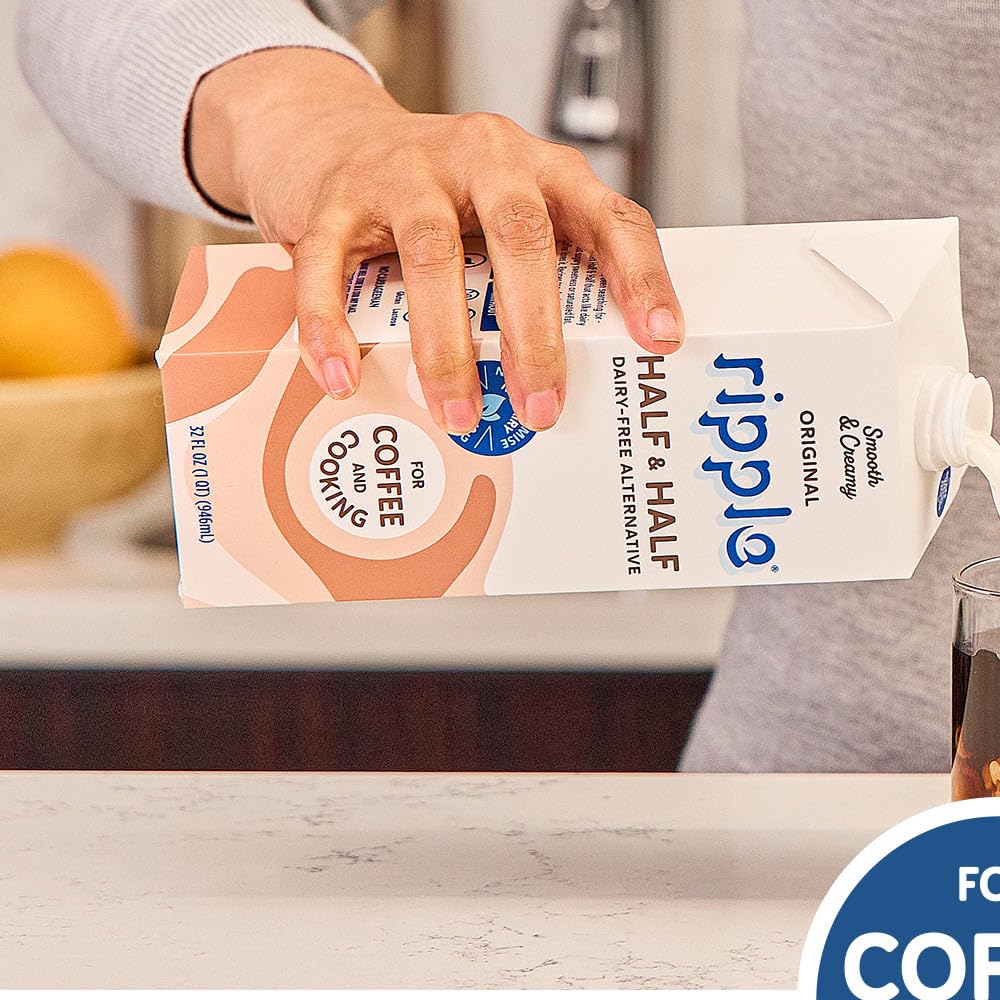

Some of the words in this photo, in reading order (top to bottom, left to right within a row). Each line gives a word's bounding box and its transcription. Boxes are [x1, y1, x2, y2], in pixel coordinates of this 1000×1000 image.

[190, 425, 204, 437] 32
[612, 356, 632, 458] DAIRY-FREE
[636, 355, 671, 450] HALF
[839, 415, 859, 432] &
[191, 440, 206, 450] FL
[192, 453, 207, 466] OZ
[372, 425, 405, 528] COFFEE
[410, 460, 425, 490] FOR
[648, 456, 666, 471] &
[699, 353, 792, 568] ripple
[800, 410, 820, 507] ORIGINAL
[840, 433, 861, 501] Creamy
[862, 426, 884, 489] Smooth
[194, 480, 211, 497] QT)
[315, 430, 368, 529] COOKING
[352, 463, 367, 493] AND
[195, 501, 215, 543] (946mL)
[620, 463, 641, 576] ALTERNATIVE
[645, 481, 679, 572] HALF
